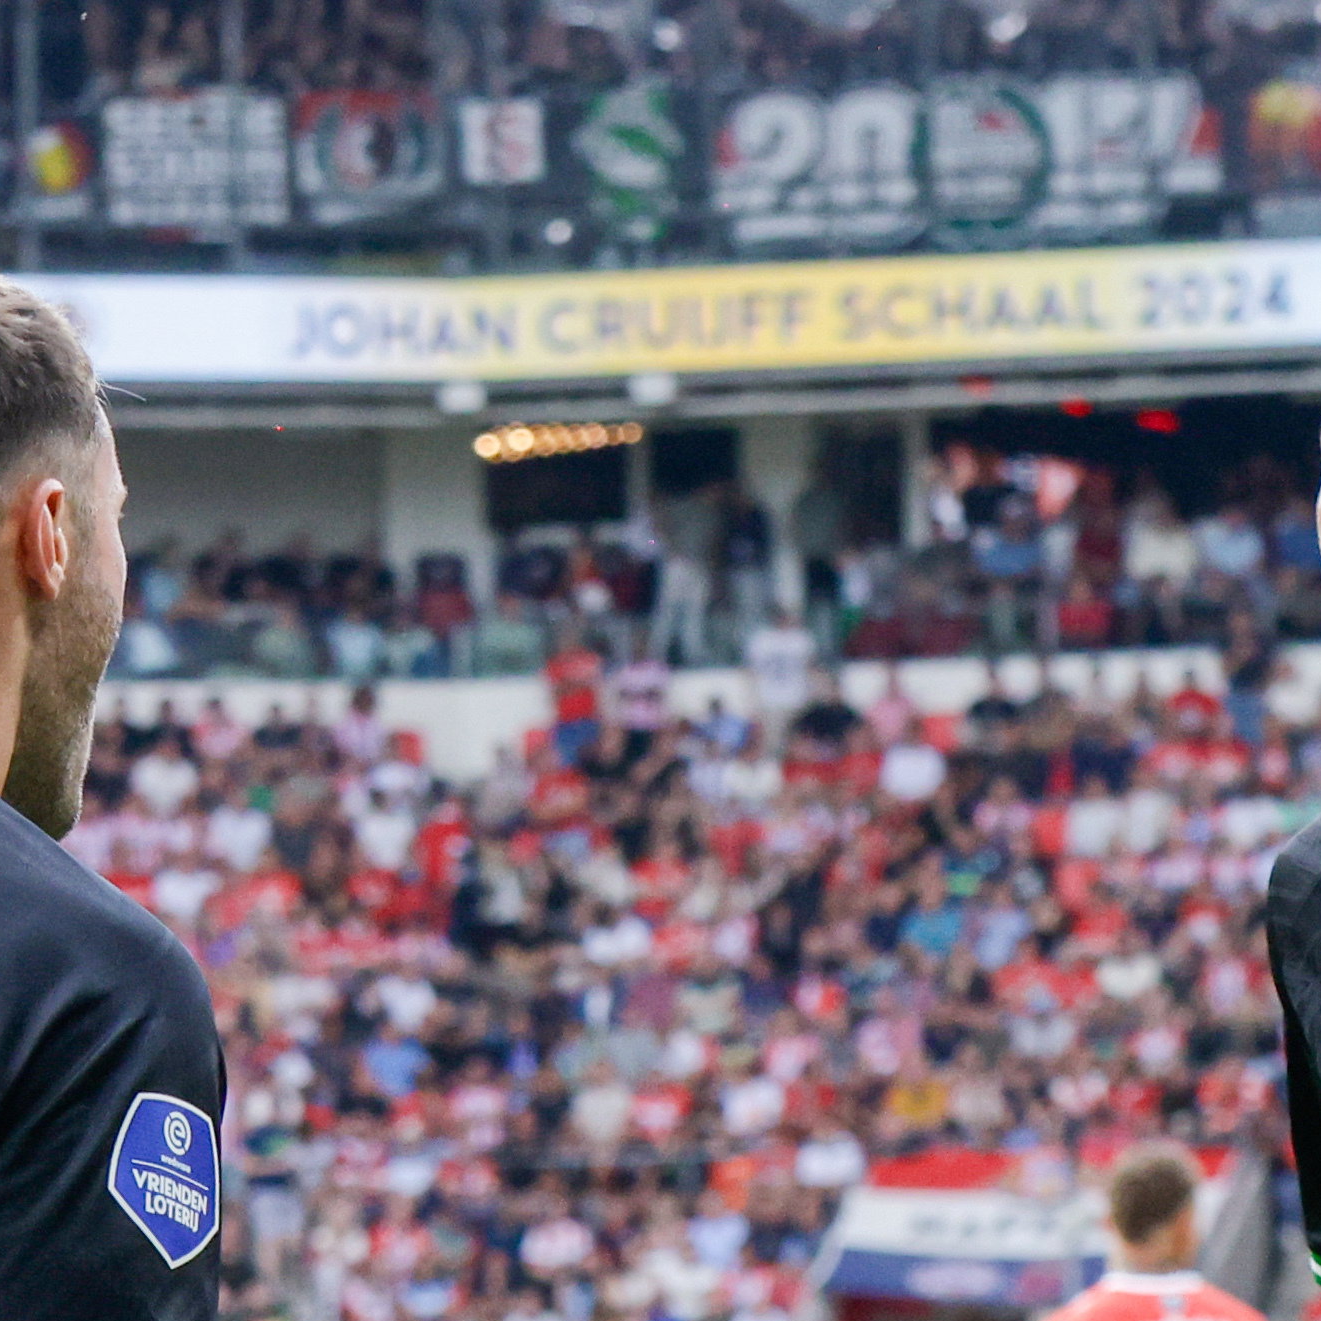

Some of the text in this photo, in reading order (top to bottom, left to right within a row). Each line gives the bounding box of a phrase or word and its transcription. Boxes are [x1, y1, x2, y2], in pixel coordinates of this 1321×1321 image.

[293, 266, 1293, 359] JOHAN CRUIJFF SCHAAL 2024
[131, 1167, 208, 1216] VRIENDEN
[144, 1193, 199, 1233] LOTERIJ
